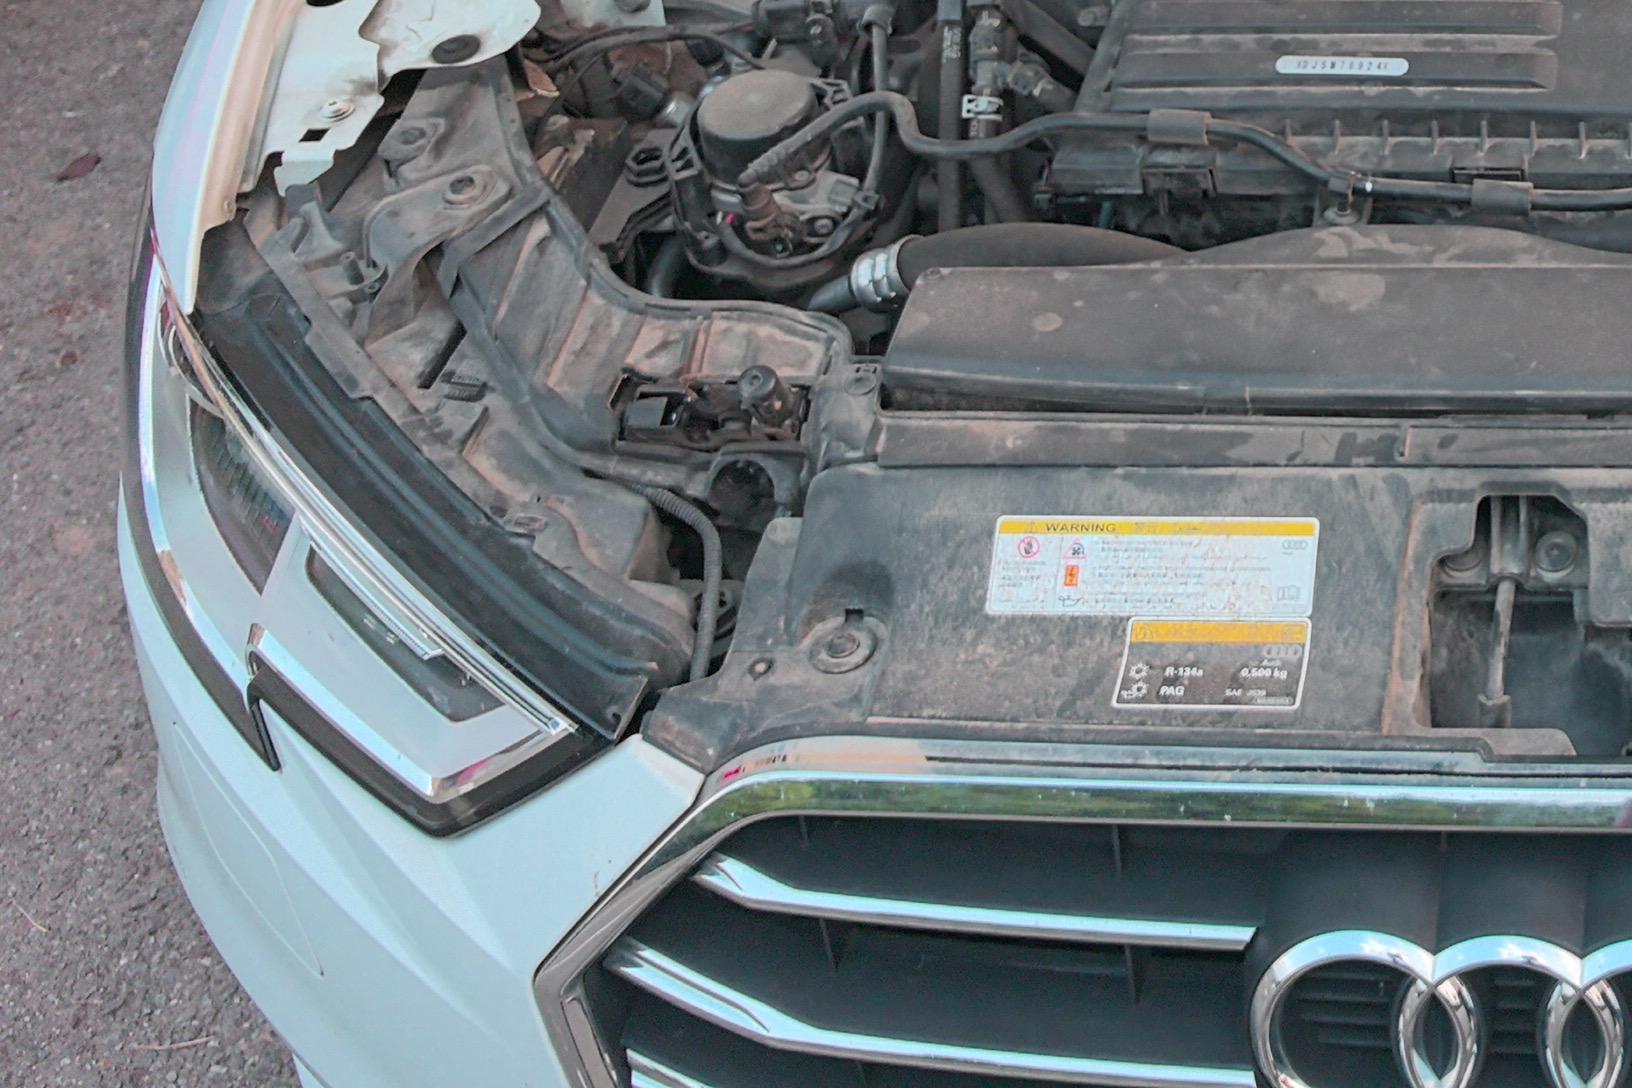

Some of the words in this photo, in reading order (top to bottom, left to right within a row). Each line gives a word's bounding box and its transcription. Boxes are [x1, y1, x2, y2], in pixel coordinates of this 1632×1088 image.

[1045, 522, 1117, 532] WARNING
[1163, 666, 1204, 677] R-134a
[1273, 667, 1288, 679] kg
[1158, 685, 1185, 696] PAG
